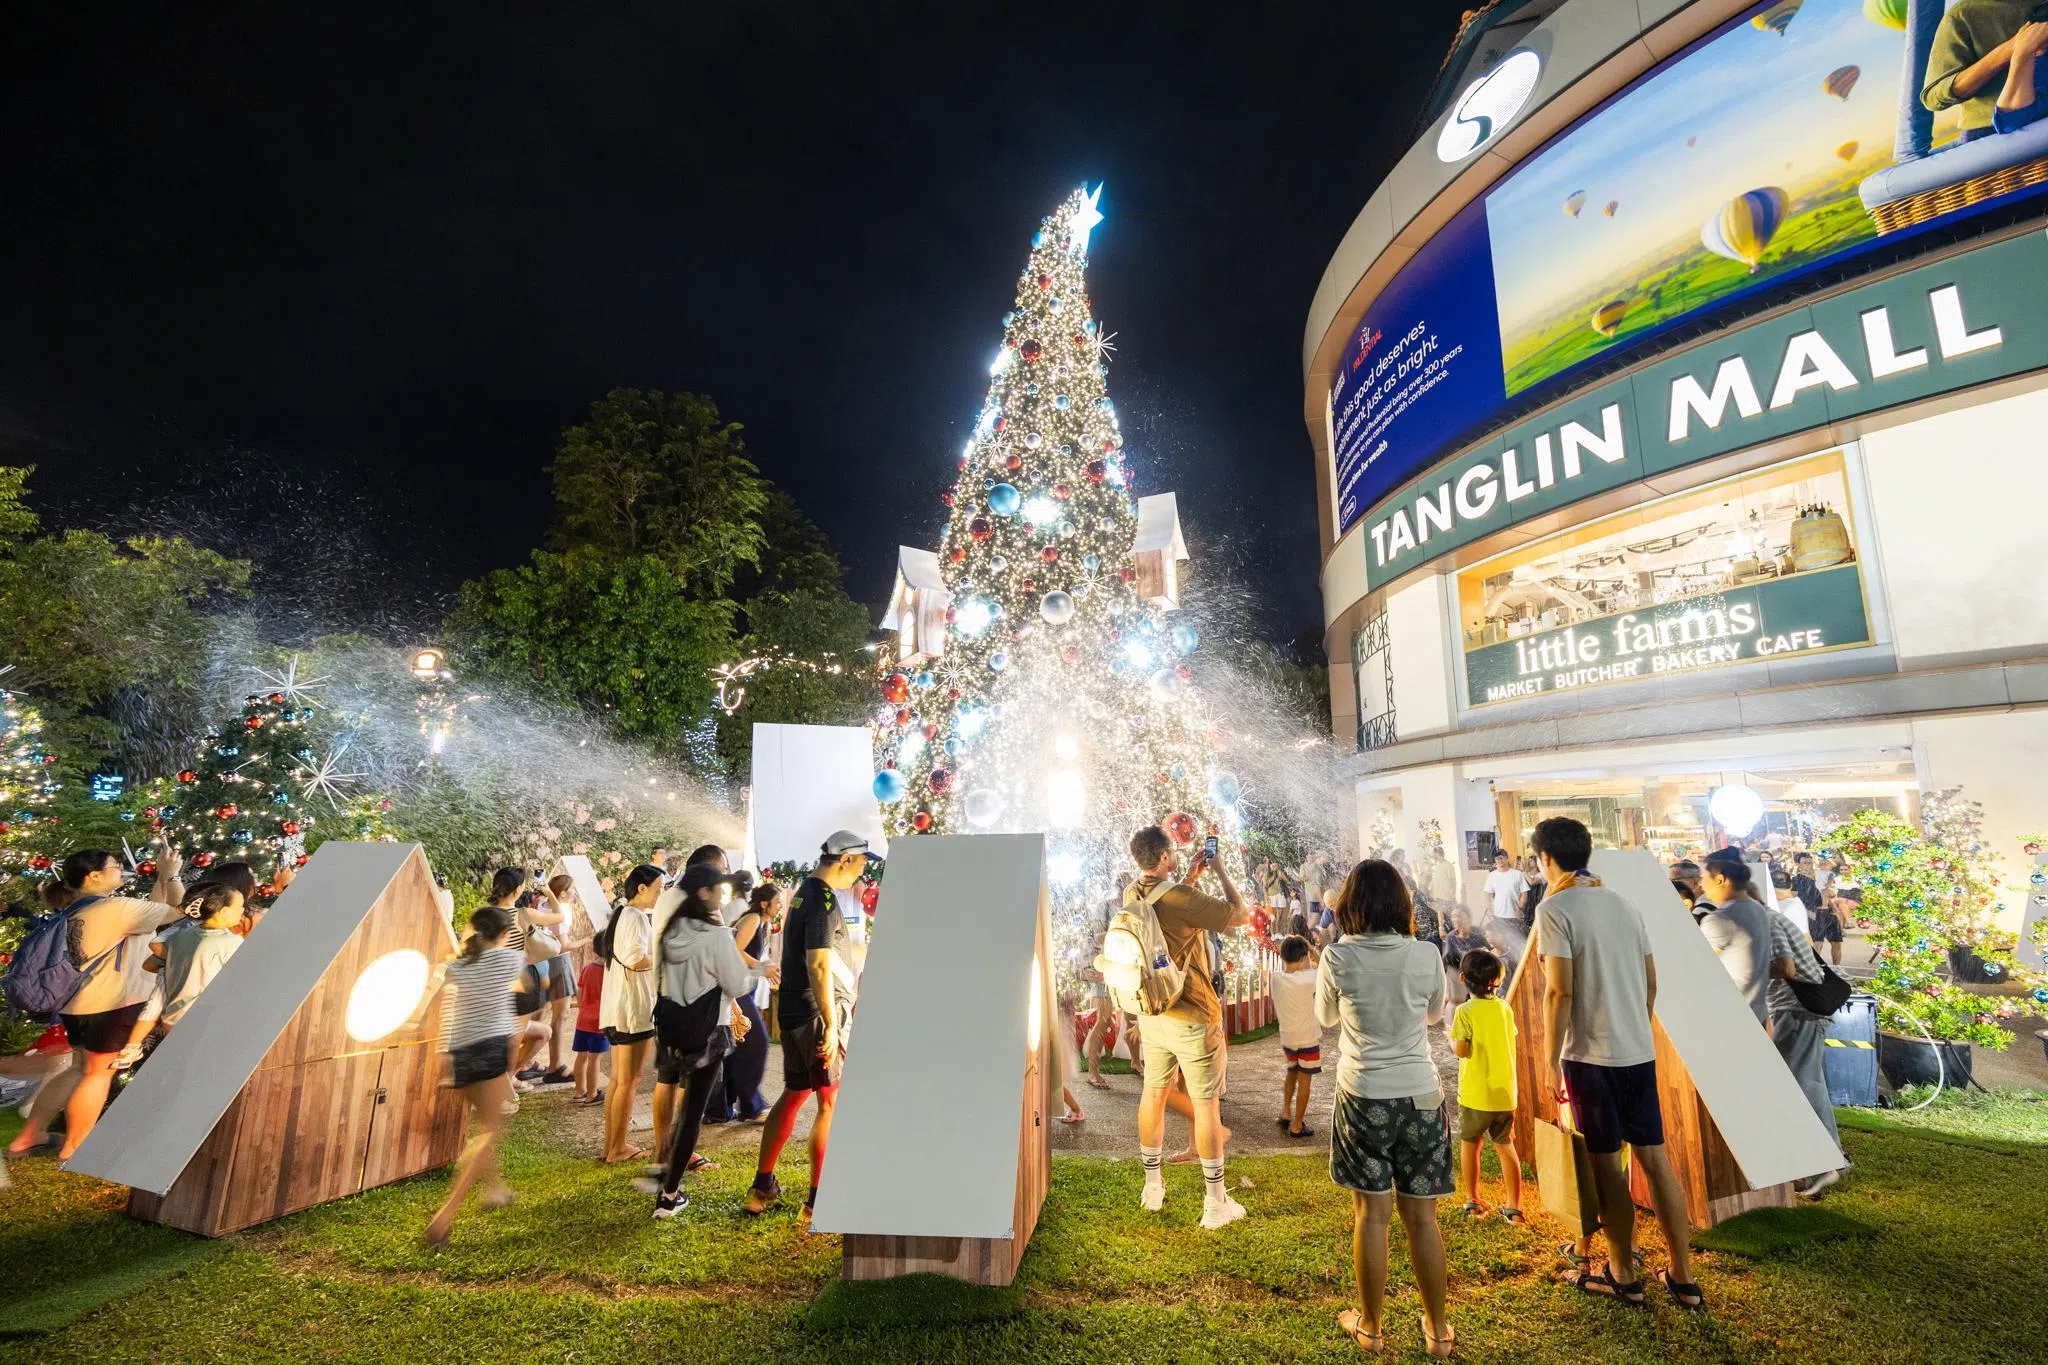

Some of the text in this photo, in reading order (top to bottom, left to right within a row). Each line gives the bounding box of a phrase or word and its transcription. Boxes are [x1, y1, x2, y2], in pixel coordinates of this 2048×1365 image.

[1343, 400, 1353, 422] this
[1354, 368, 1375, 409] good
[1375, 320, 1425, 377] deserves
[1352, 328, 1383, 373] PRUDENTIAL
[1368, 401, 1393, 431] Prudential
[1392, 387, 1408, 406] bring
[1408, 373, 1424, 390] over
[1424, 359, 1439, 378] 300
[1440, 344, 1463, 368] years
[1338, 405, 1366, 457] retirement
[1366, 386, 1383, 419] just
[1384, 373, 1397, 392] as
[1398, 334, 1438, 379] bright
[1371, 284, 2003, 567] TANGLIN MALL
[1373, 425, 1382, 439] can
[1382, 413, 1395, 431] plan
[1394, 400, 1408, 417] with
[1408, 369, 1449, 404] confidence.
[1368, 440, 1388, 464] wealth
[1487, 629, 1825, 703] MARKET BUTCHER BAKERY CAFE
[1516, 600, 1757, 676] little farms
